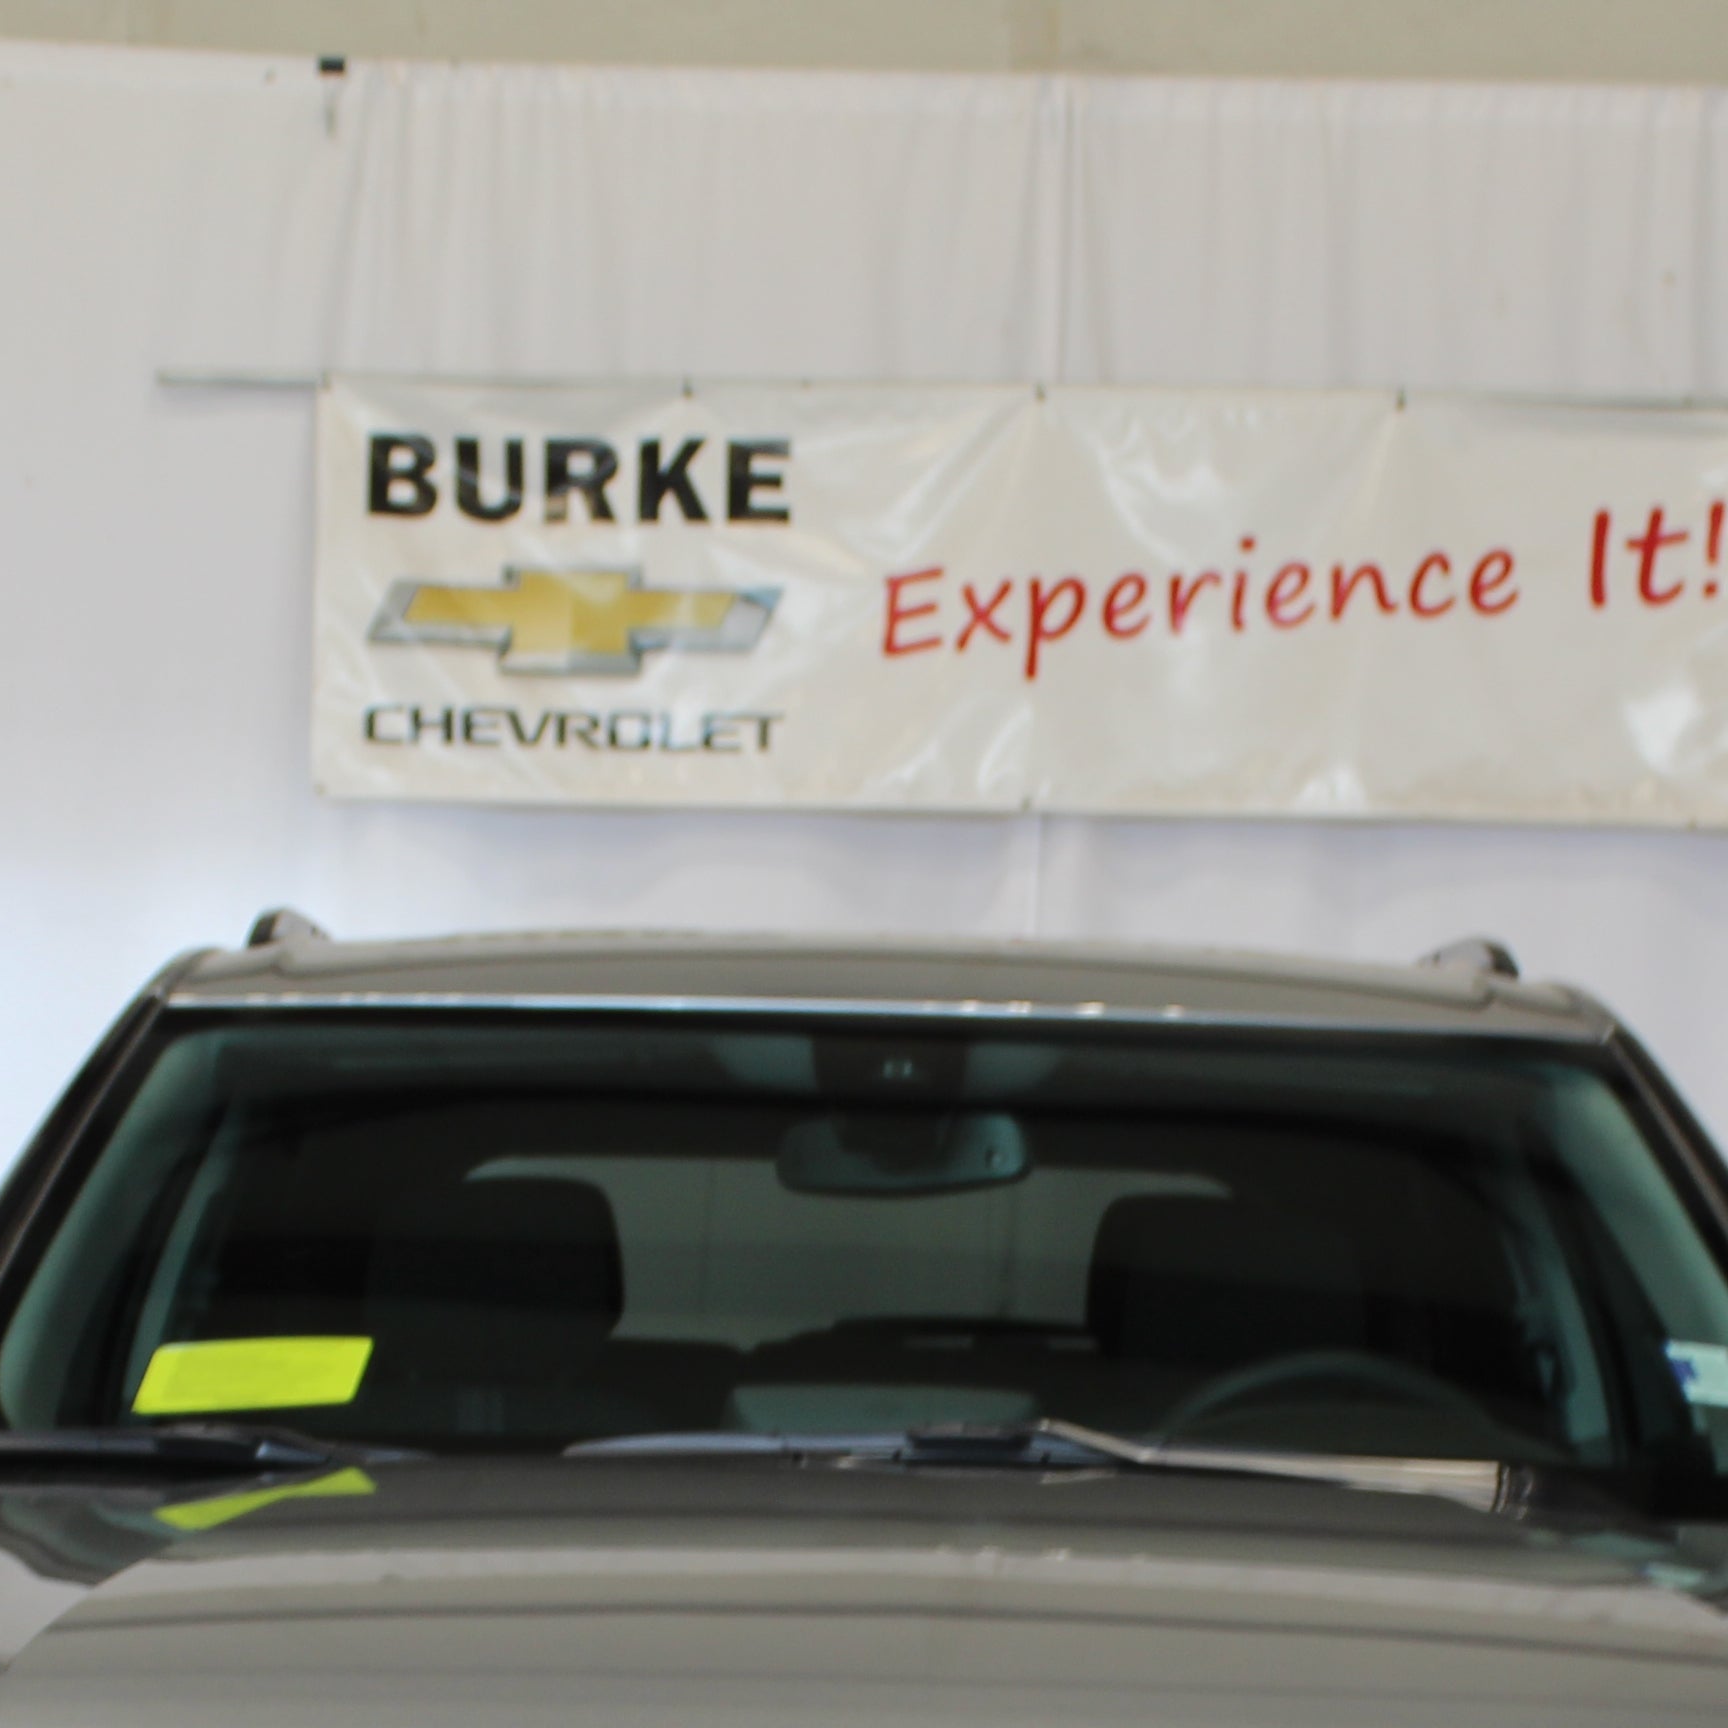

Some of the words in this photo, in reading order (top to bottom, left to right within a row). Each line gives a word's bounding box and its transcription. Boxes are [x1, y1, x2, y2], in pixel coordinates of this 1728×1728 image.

[367, 433, 791, 525] BURKE
[881, 535, 1520, 682] Experience
[1587, 498, 1728, 612] It!
[364, 704, 786, 753] CHEVROLET
